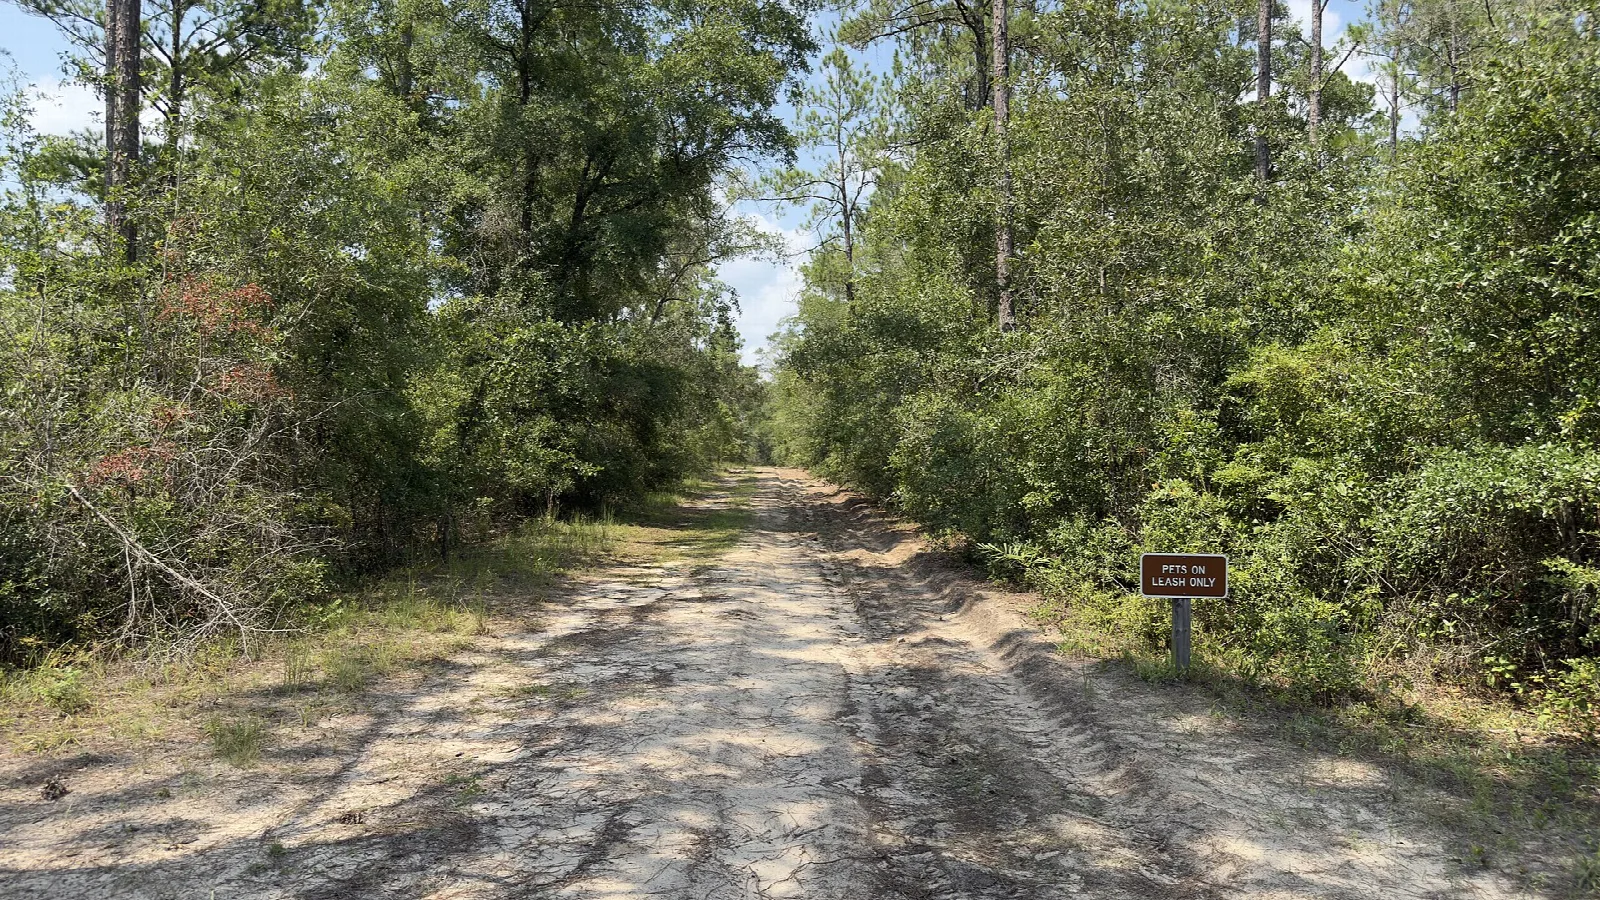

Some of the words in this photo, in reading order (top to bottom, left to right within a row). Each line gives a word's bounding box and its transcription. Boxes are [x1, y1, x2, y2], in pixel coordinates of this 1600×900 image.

[1162, 564, 1187, 574] PETS
[1192, 566, 1206, 574] ON
[1152, 577, 1186, 586] LEASH
[1190, 578, 1216, 587] ONLY
